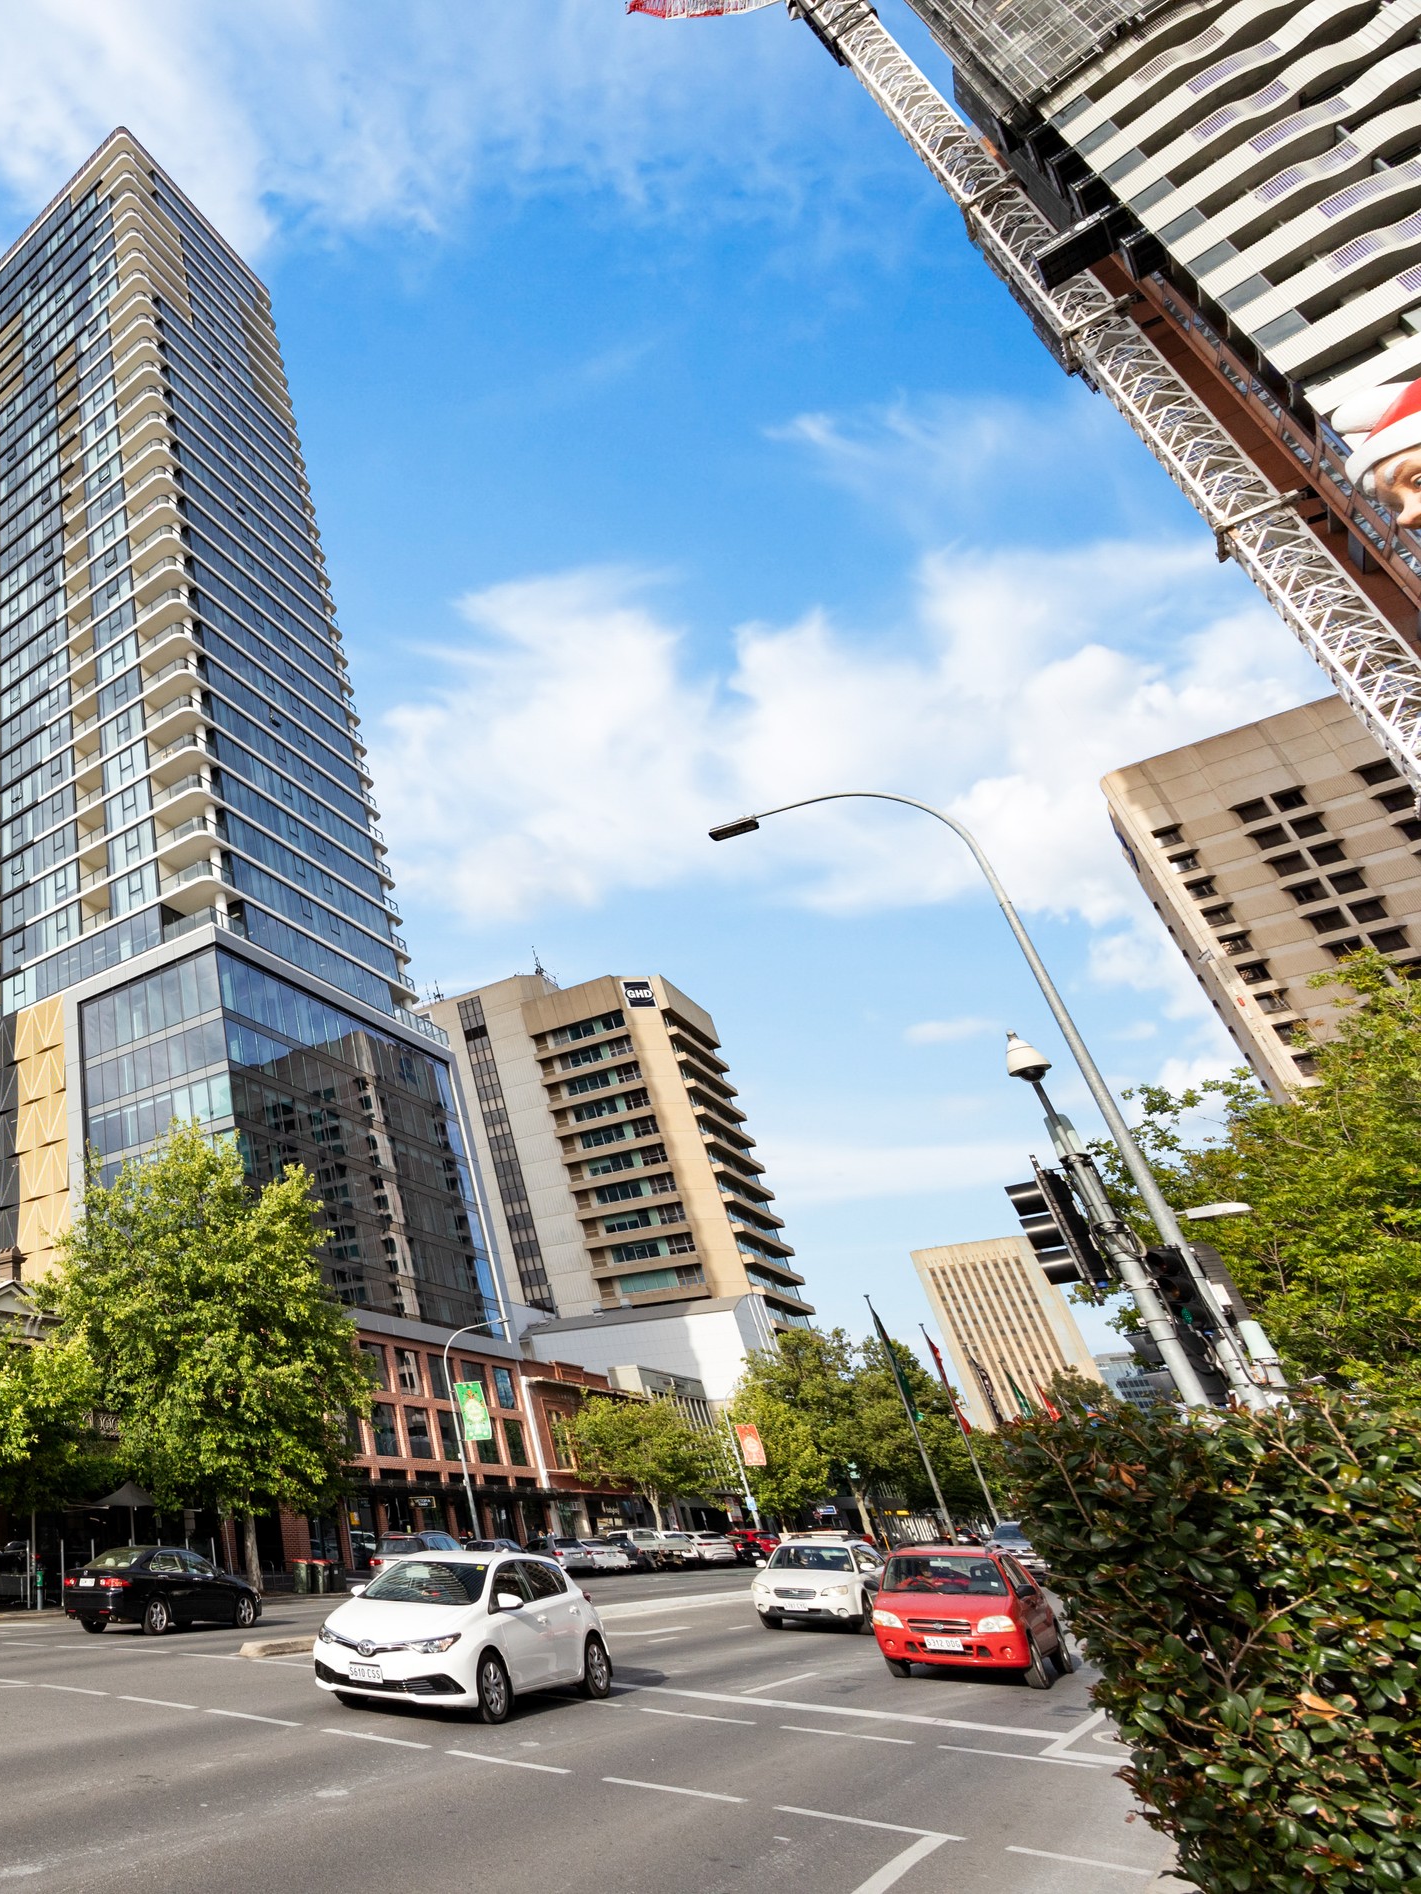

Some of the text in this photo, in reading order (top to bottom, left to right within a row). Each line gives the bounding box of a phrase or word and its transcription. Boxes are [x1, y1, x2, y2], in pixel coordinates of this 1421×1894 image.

[626, 989, 653, 999] GHD
[349, 1667, 381, 1679] S610 CSS
